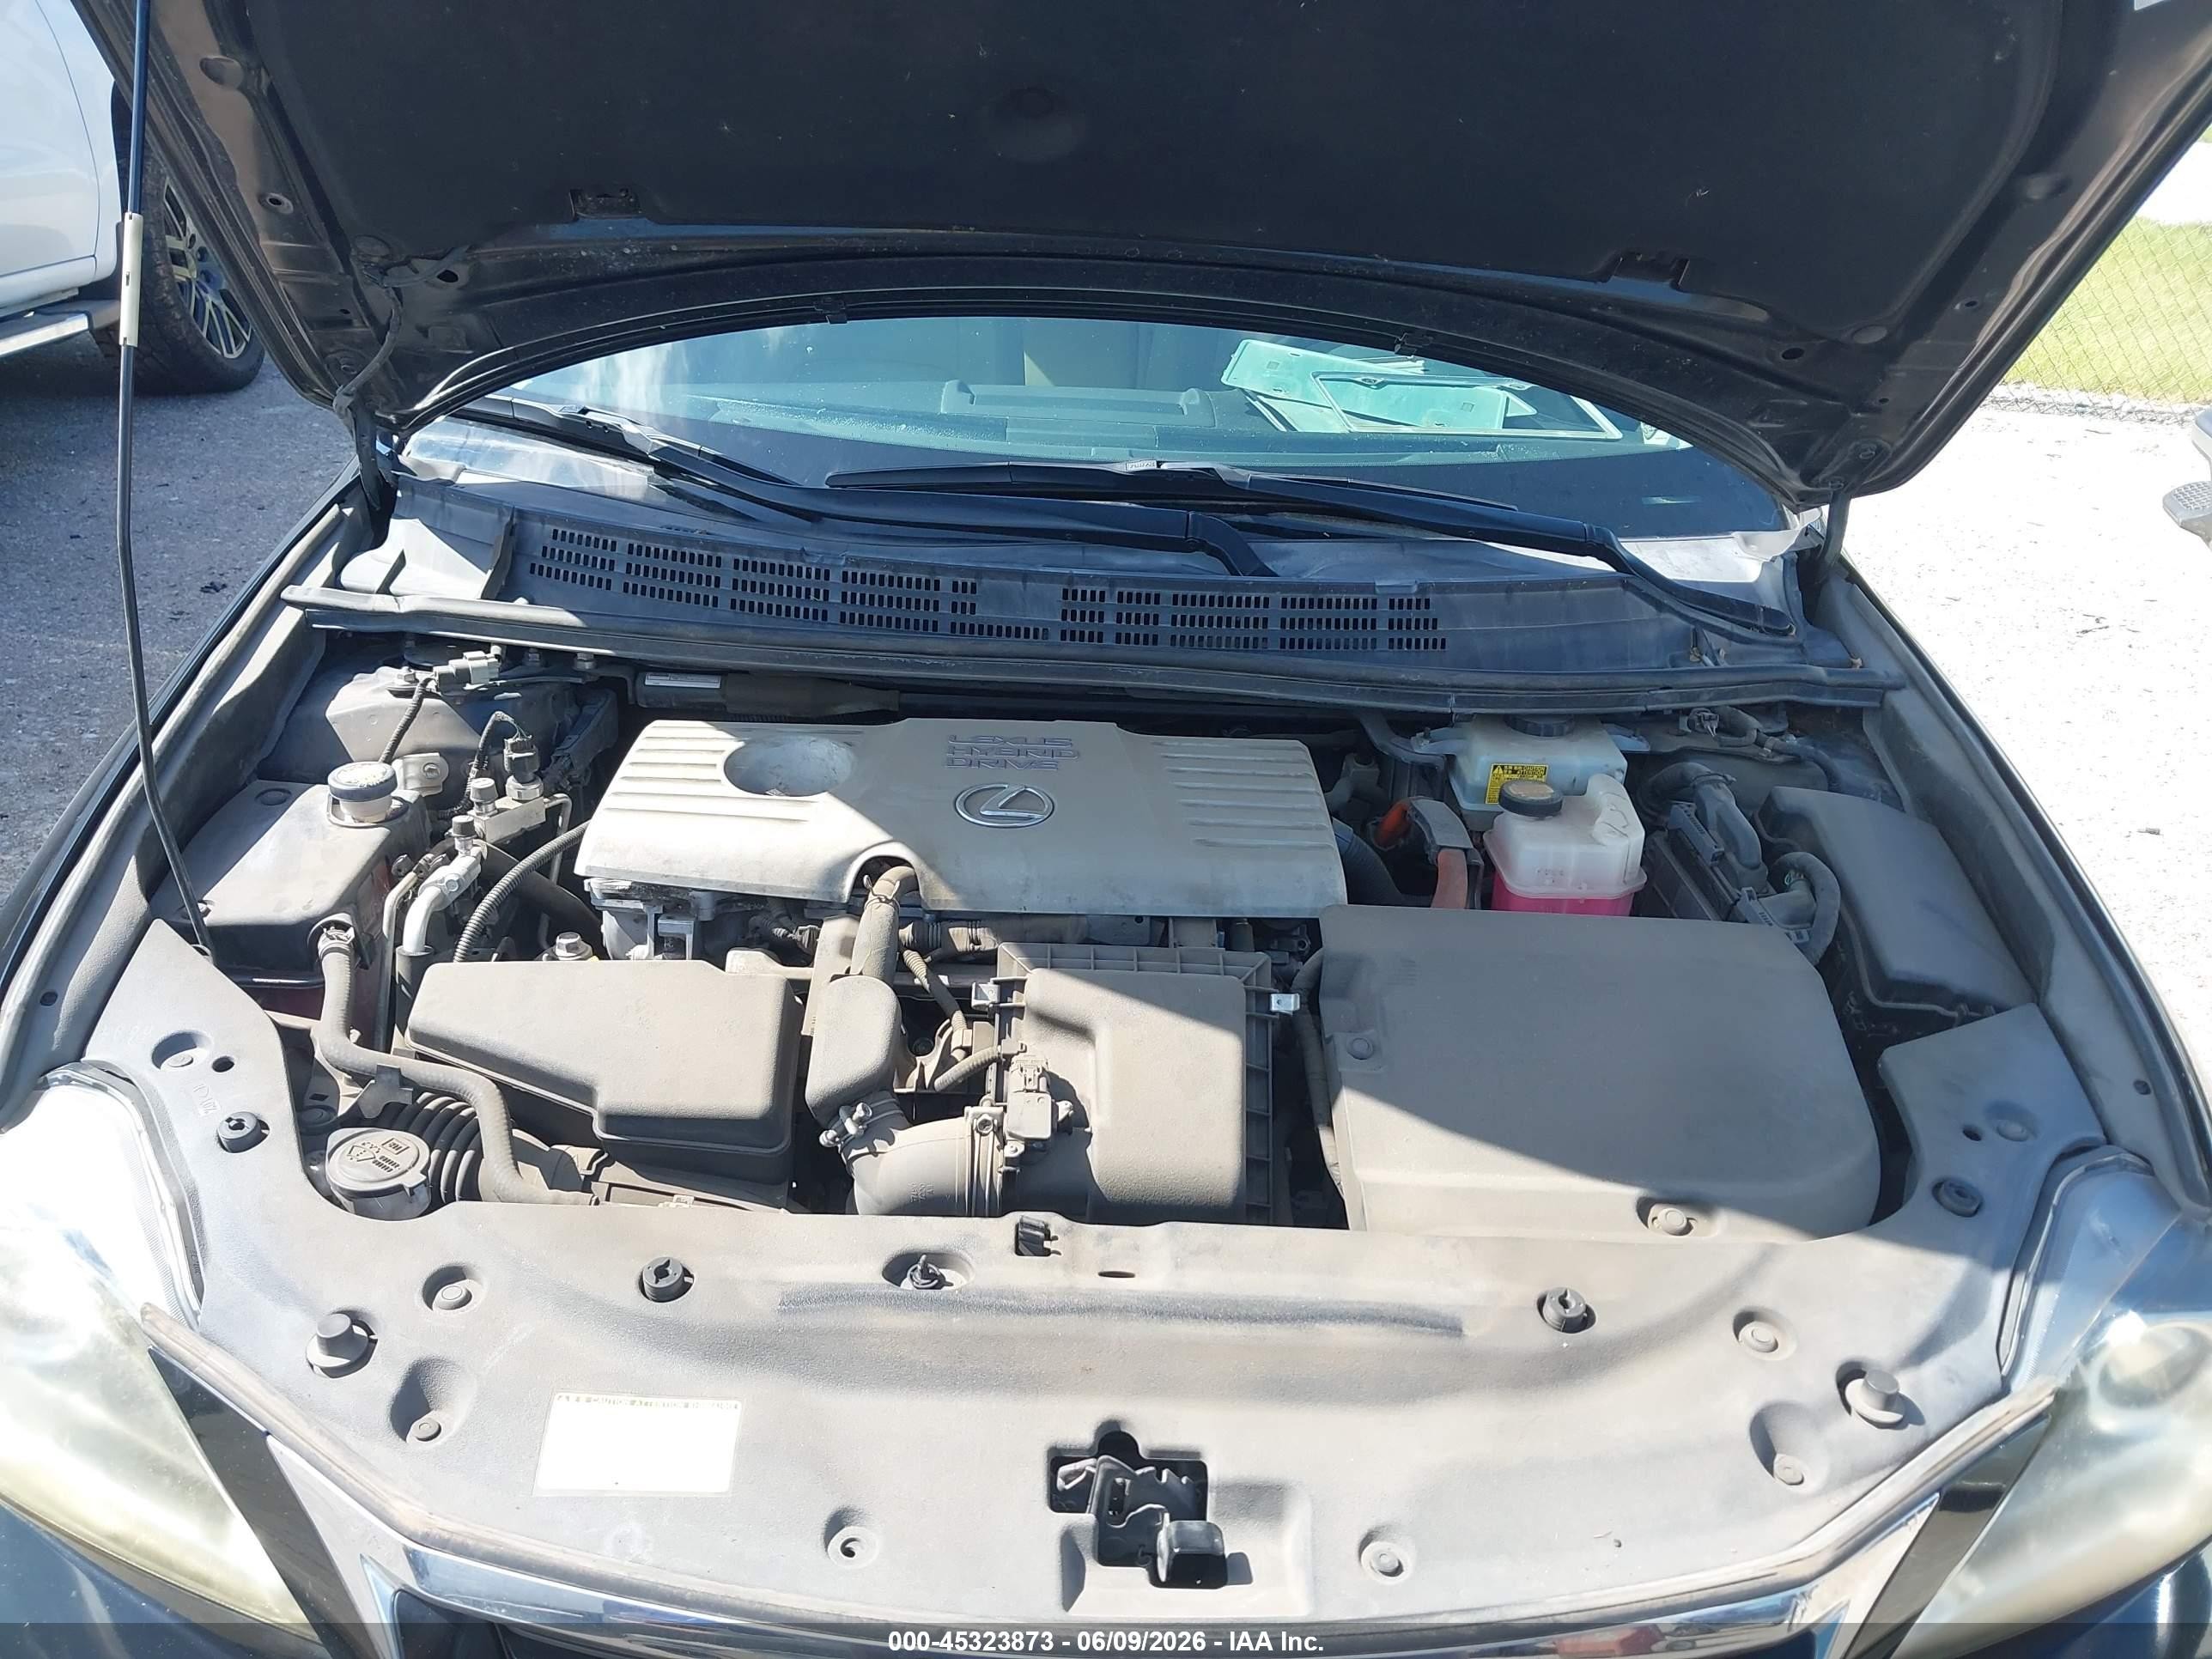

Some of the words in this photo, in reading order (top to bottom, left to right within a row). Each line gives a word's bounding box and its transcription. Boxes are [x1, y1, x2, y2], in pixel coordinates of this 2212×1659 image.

[947, 735, 1073, 747] LEXUS
[945, 745, 1080, 759] HYBRID
[945, 757, 1060, 770] DRIVE
